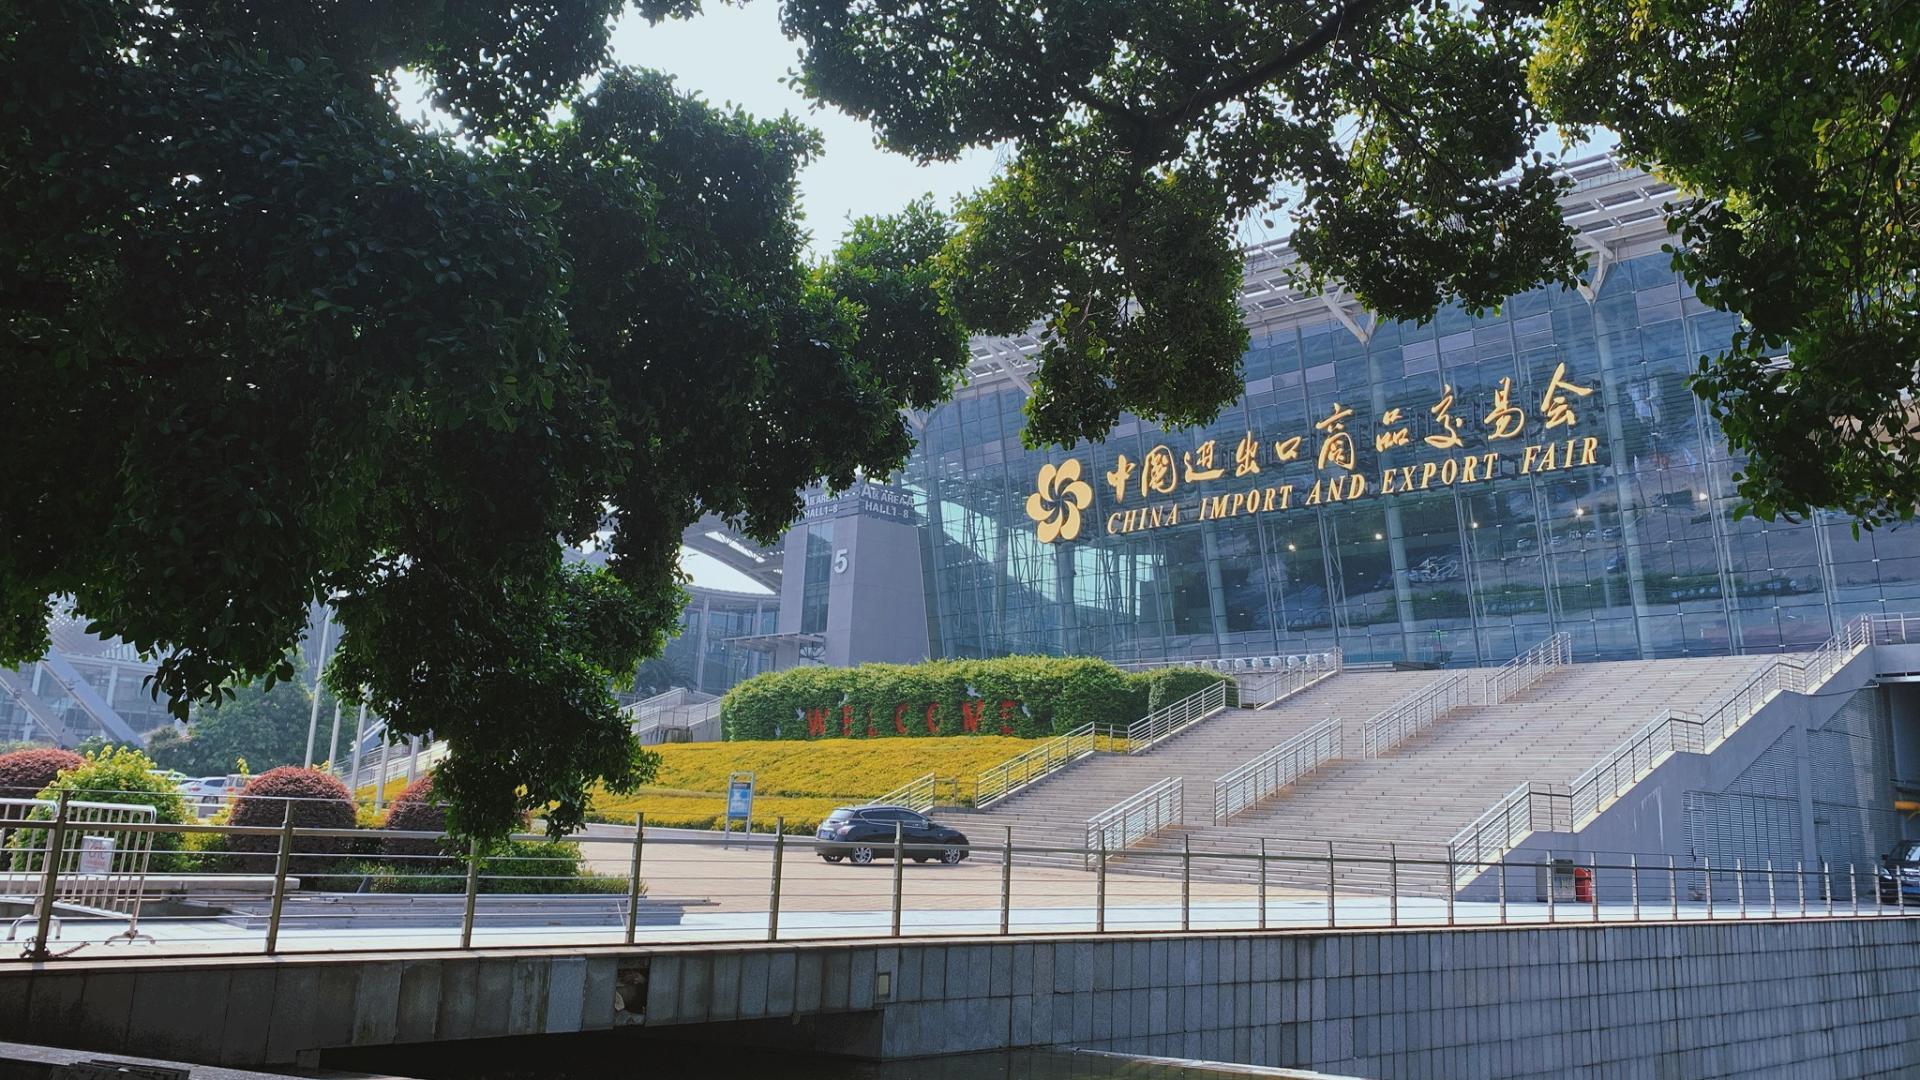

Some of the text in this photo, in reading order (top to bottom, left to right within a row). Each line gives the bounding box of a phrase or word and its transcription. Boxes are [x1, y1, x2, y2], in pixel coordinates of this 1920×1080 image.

[1107, 437, 1598, 534] CHINA IMPORT AND EXPORT FAIR
[833, 549, 848, 574] 5
[806, 699, 1016, 737] WELCOME
